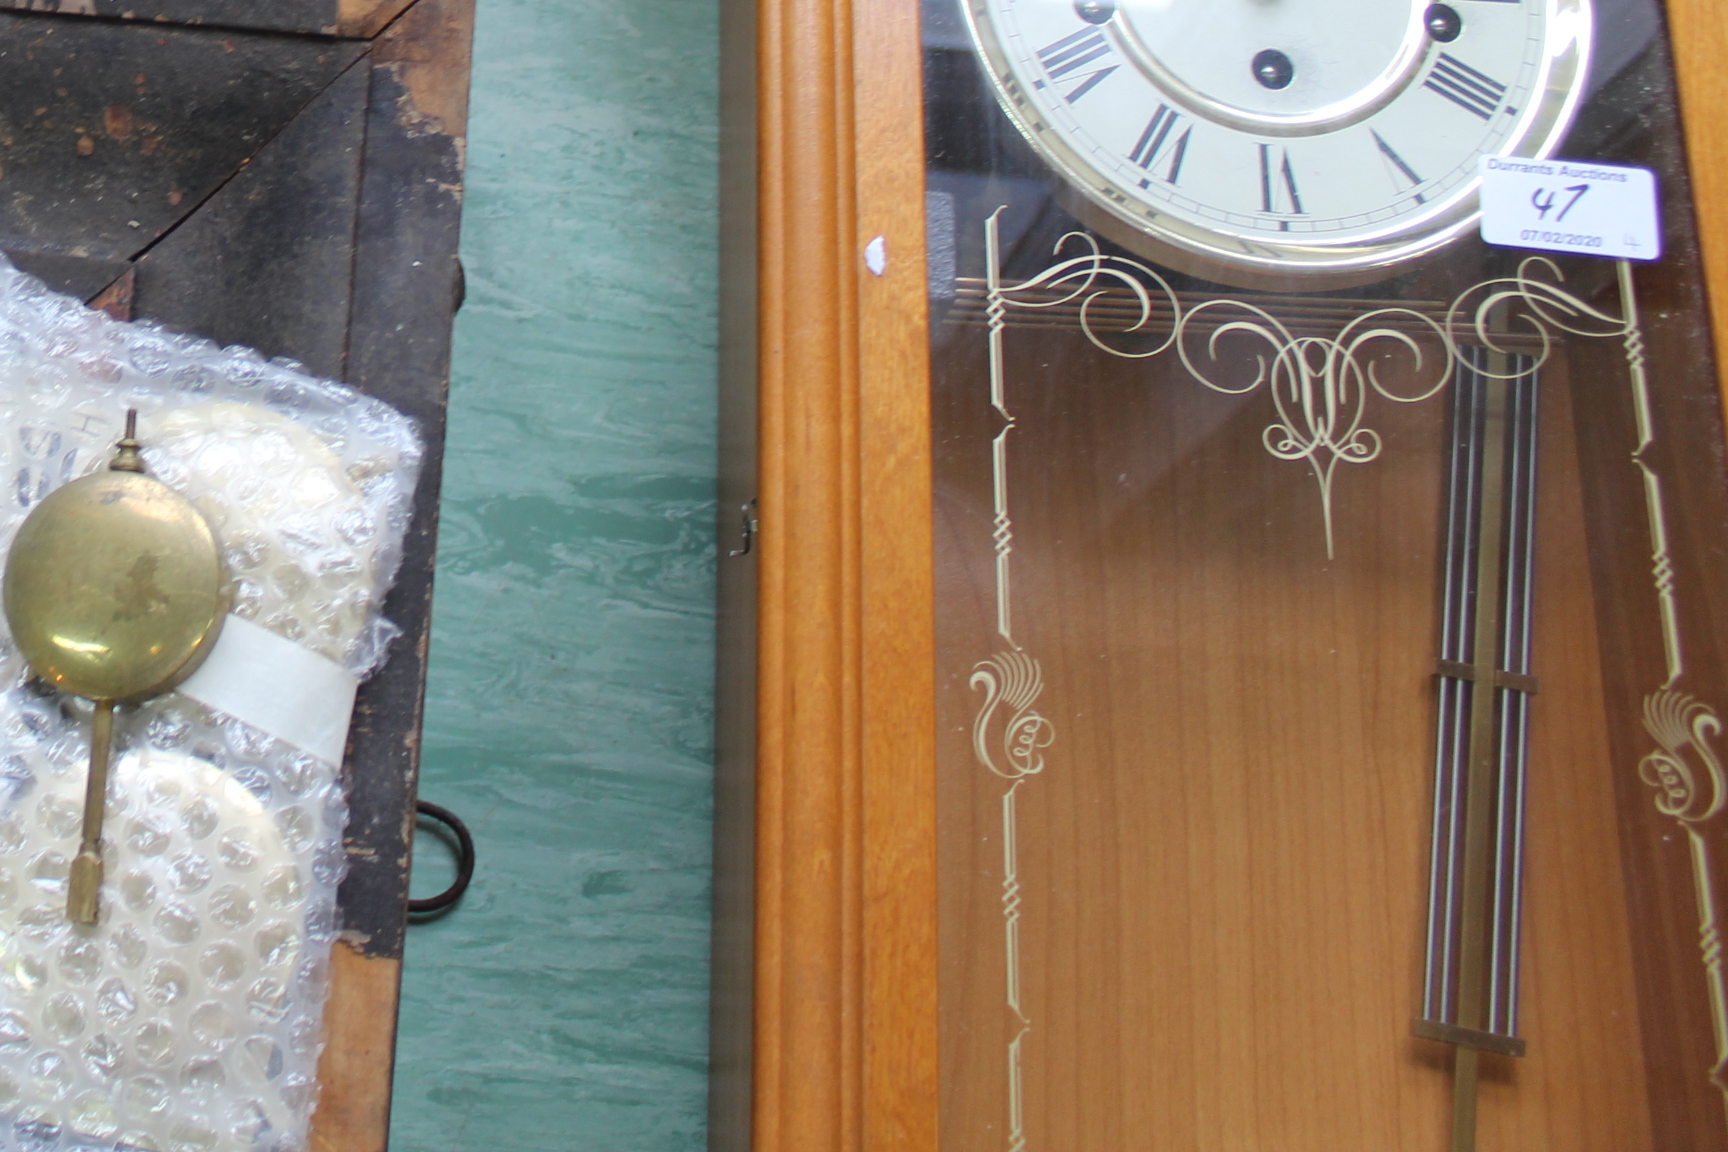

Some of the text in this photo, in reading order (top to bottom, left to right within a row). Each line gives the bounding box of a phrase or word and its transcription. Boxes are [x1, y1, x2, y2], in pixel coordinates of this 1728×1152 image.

[1488, 158, 1628, 183] Durrants Auctions
[1530, 183, 1591, 223] 47
[1521, 230, 1603, 247] 07/02/2020
